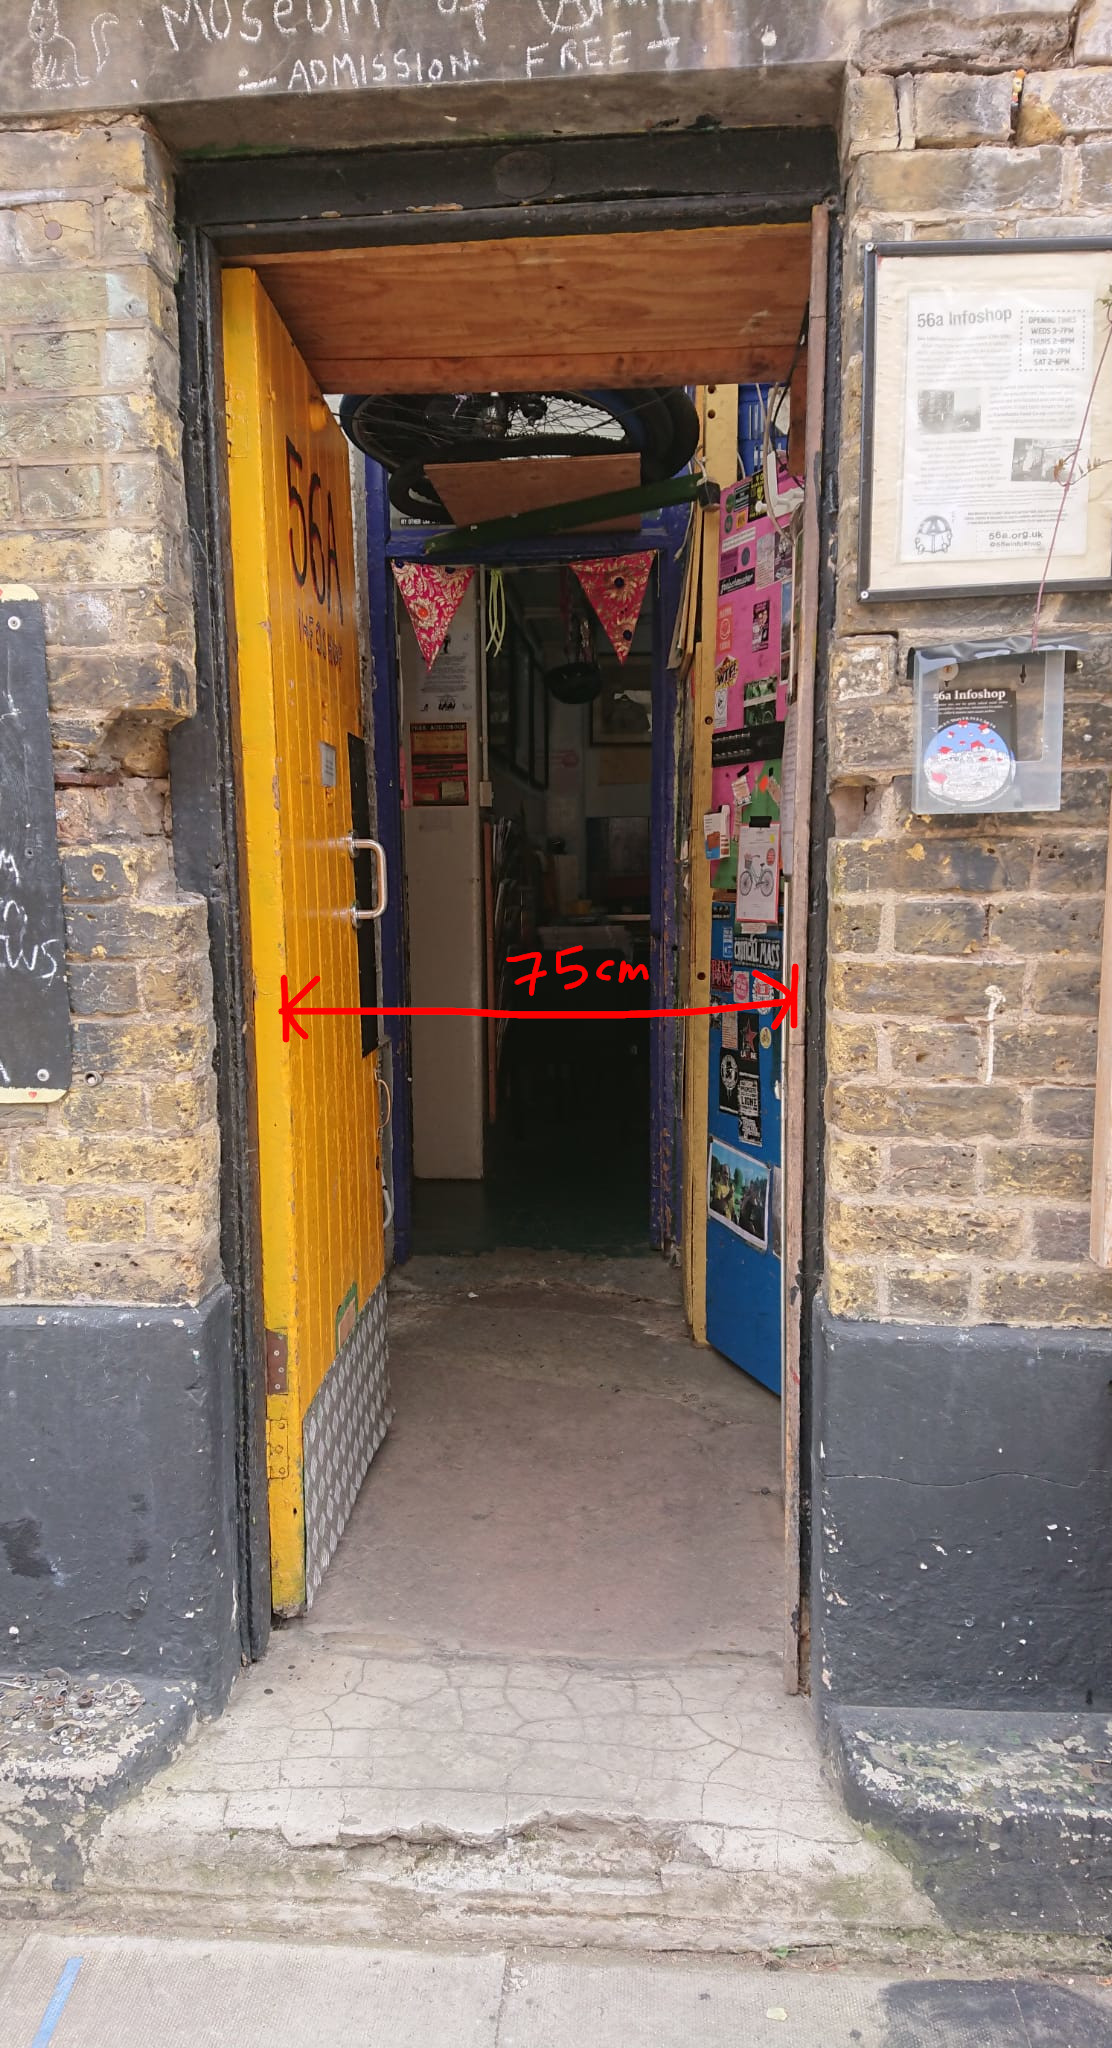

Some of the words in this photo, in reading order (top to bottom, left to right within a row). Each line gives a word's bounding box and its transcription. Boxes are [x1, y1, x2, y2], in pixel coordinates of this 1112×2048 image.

[525, 30, 632, 79] FREE
[917, 312, 944, 328] 56a
[948, 308, 1012, 326] Infoshop
[1031, 327, 1051, 335] WEDS
[286, 435, 344, 627] 56A
[988, 530, 1044, 541] 56a.org.uk
[932, 690, 952, 704] 56a
[954, 688, 1006, 701] Infoshop
[734, 940, 760, 963] CRITICAL
[759, 941, 780, 970] MASS
